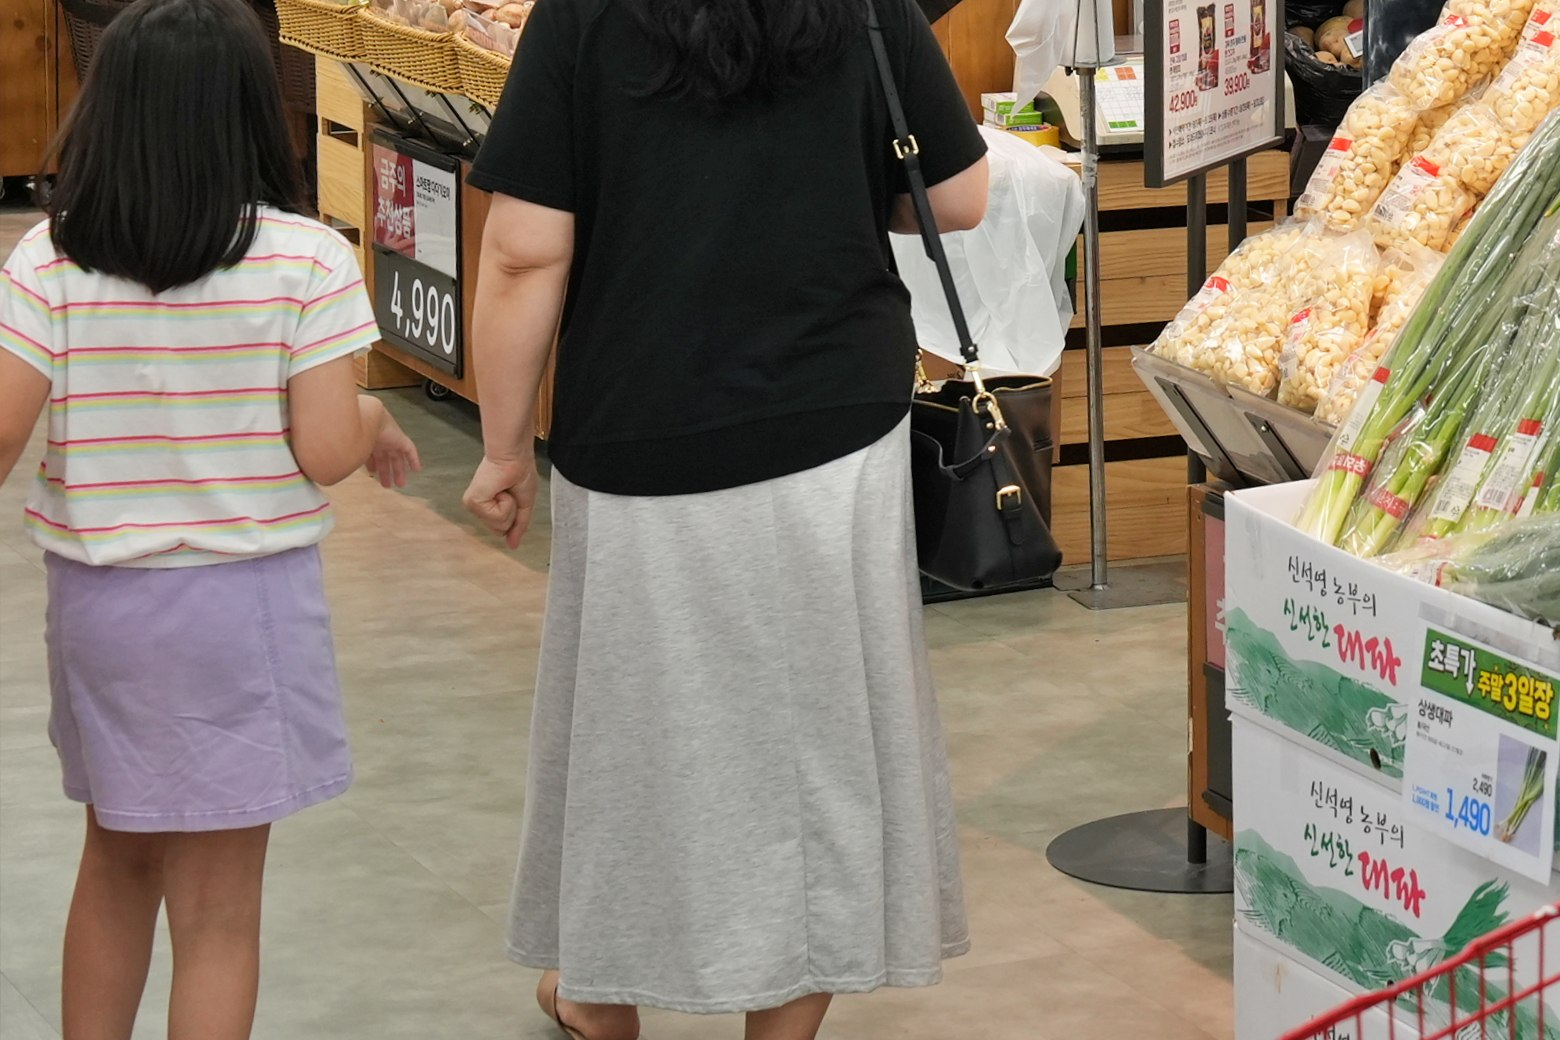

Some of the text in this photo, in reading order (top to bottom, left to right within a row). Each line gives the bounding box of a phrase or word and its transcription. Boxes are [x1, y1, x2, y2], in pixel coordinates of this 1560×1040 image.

[379, 156, 407, 198] 금주의
[376, 197, 414, 241] 추천상품
[390, 271, 456, 356] 4,990
[1333, 576, 1377, 618] 농부의
[1284, 597, 1402, 688] 신선한 대파
[1428, 638, 1477, 698] 초특가
[1417, 698, 1454, 729] 상생대파
[1472, 777, 1493, 799] 2,490
[1361, 805, 1406, 849] 농부의
[1444, 787, 1491, 838] 1,490
[1304, 822, 1427, 920] 신선한 대파
